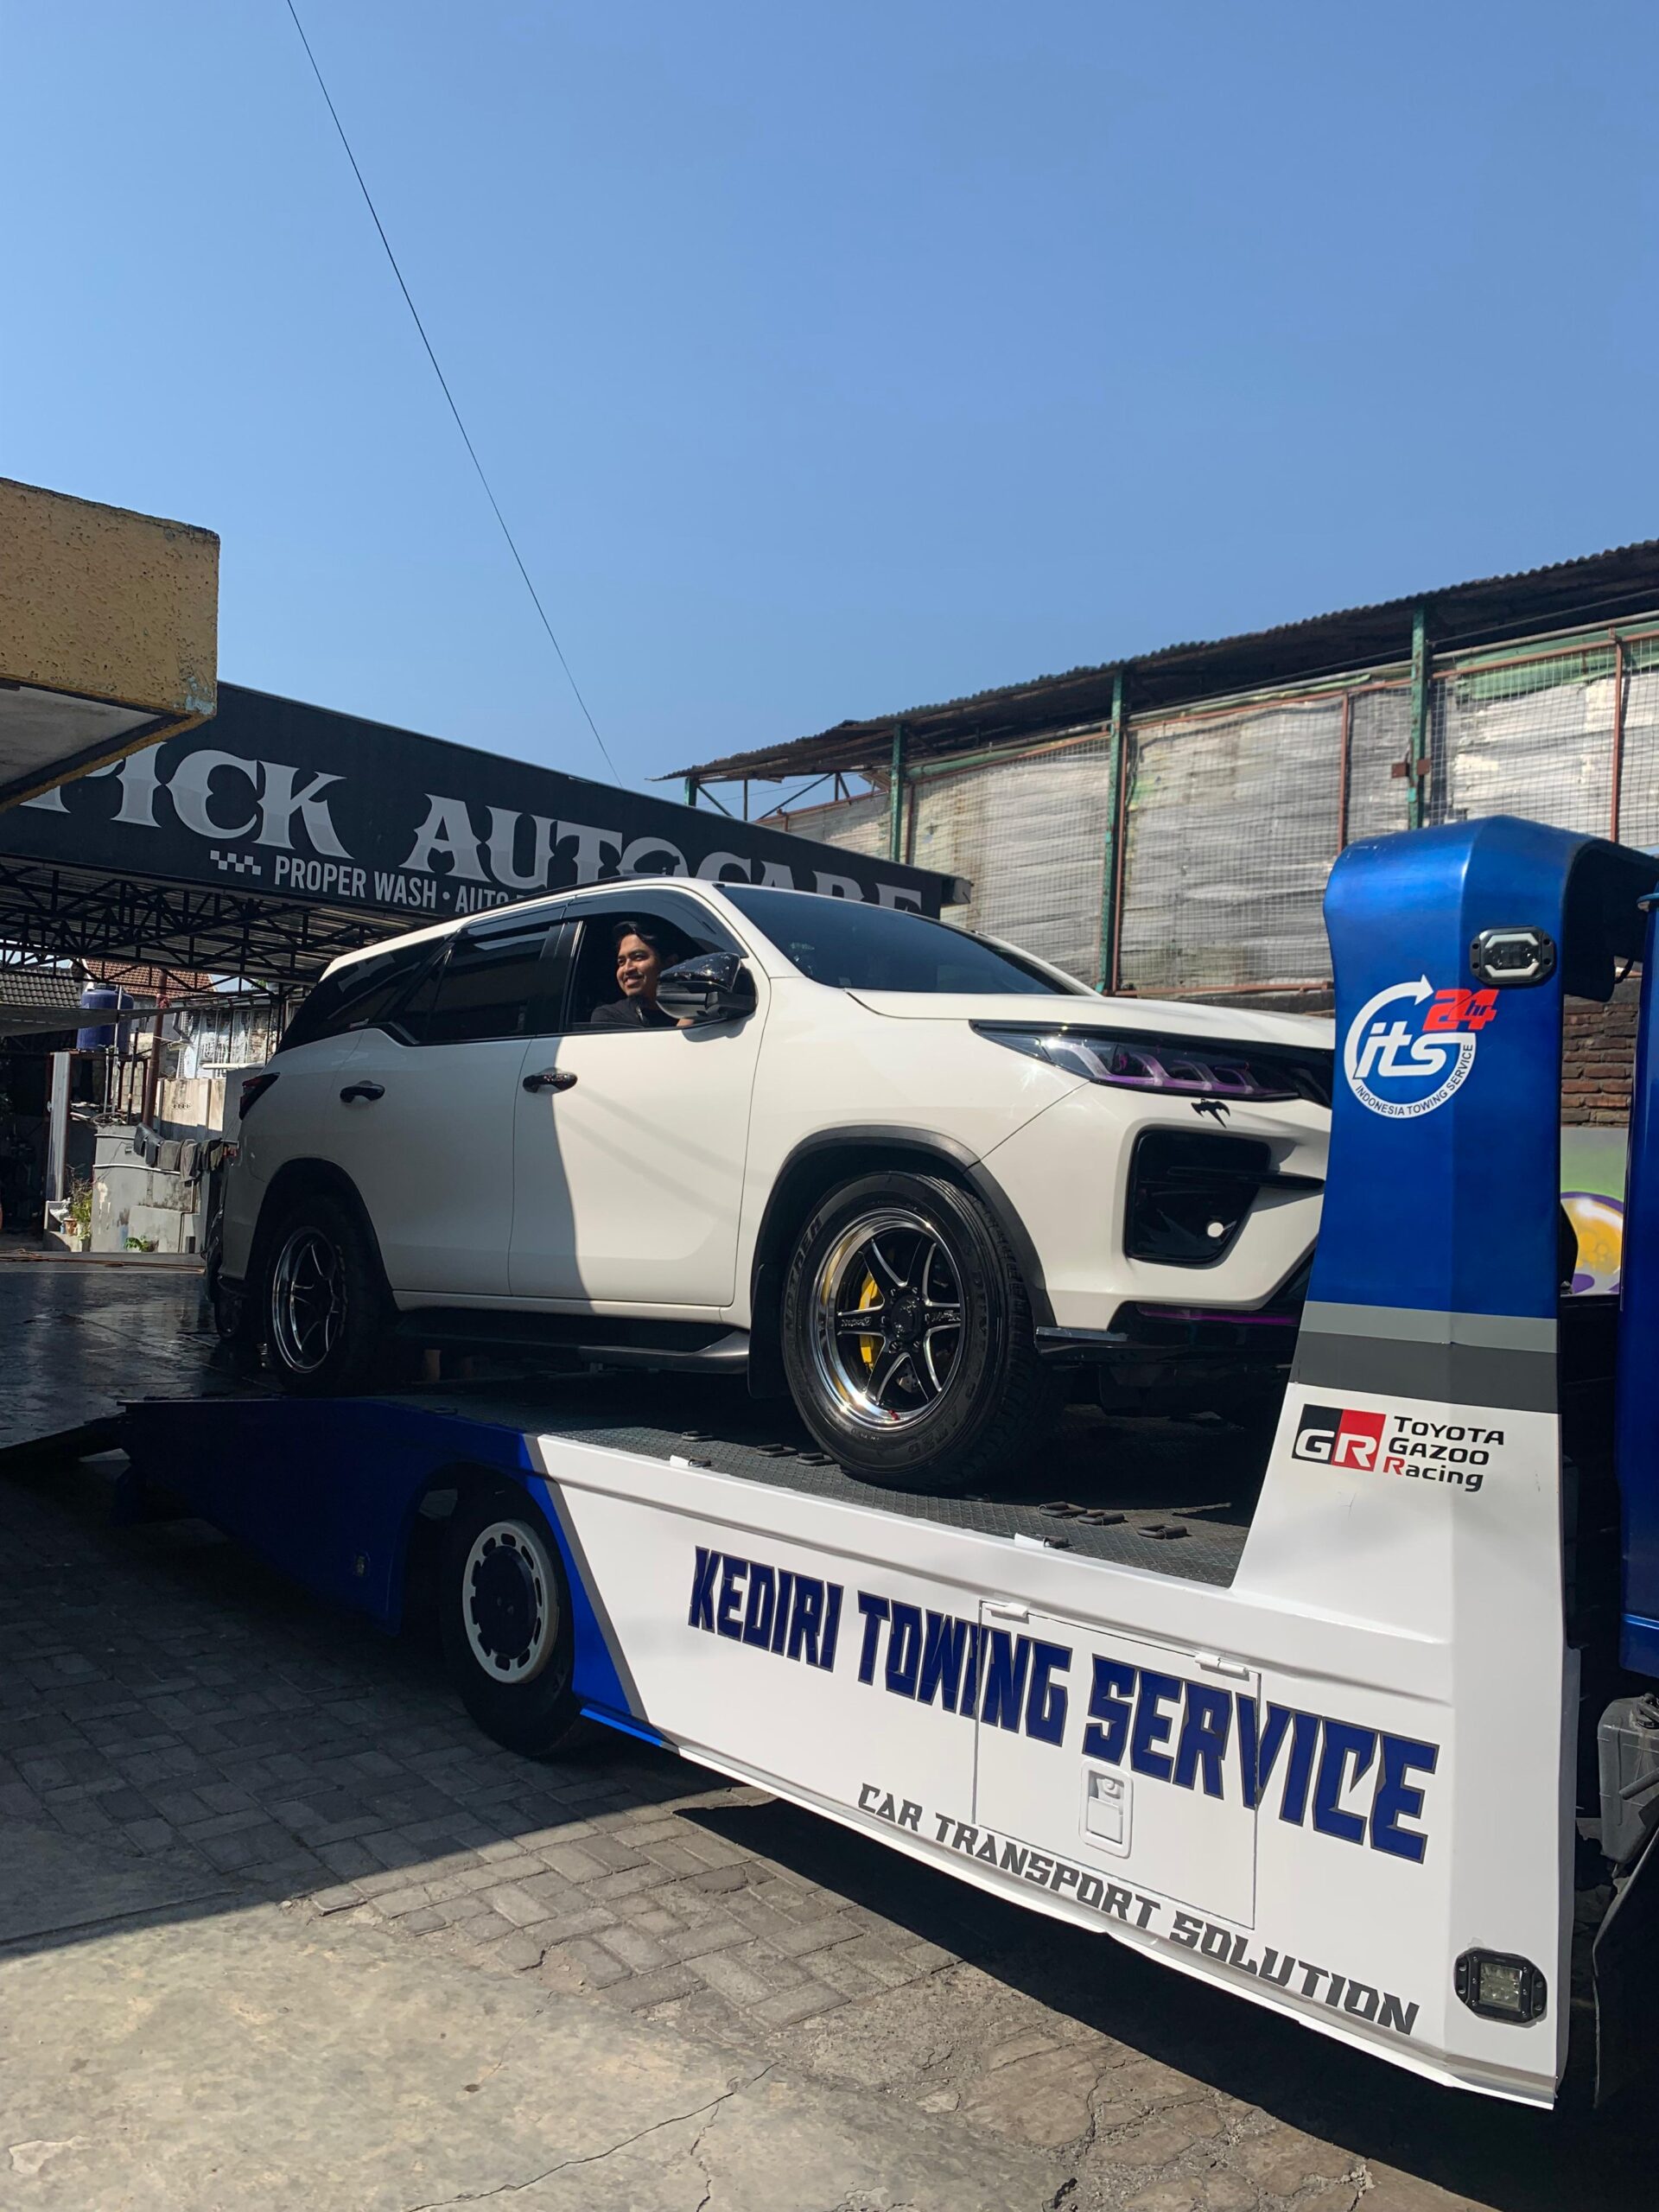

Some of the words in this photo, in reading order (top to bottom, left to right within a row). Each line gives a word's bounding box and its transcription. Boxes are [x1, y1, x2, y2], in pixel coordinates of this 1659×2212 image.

[274, 855, 366, 898] PROPER
[374, 871, 436, 908] WASH
[1355, 1084, 1406, 1116] INDONESIA
[1404, 1089, 1448, 1116] TOWING
[1446, 1044, 1473, 1091] SERVICE
[1294, 1427, 1377, 1468] GR
[1388, 1436, 1490, 1466] GAZOO
[1393, 1414, 1504, 1446] TOYOTA
[1382, 1455, 1484, 1492] Racing
[689, 1545, 844, 1672] KEDIRI
[857, 1590, 1073, 1747] TOWING
[1082, 1653, 1440, 1865] SERVICE
[859, 1783, 923, 1832] CAR
[934, 1812, 1160, 1930] TRANSPORT
[1169, 1910, 1420, 2036] SOLUTION
